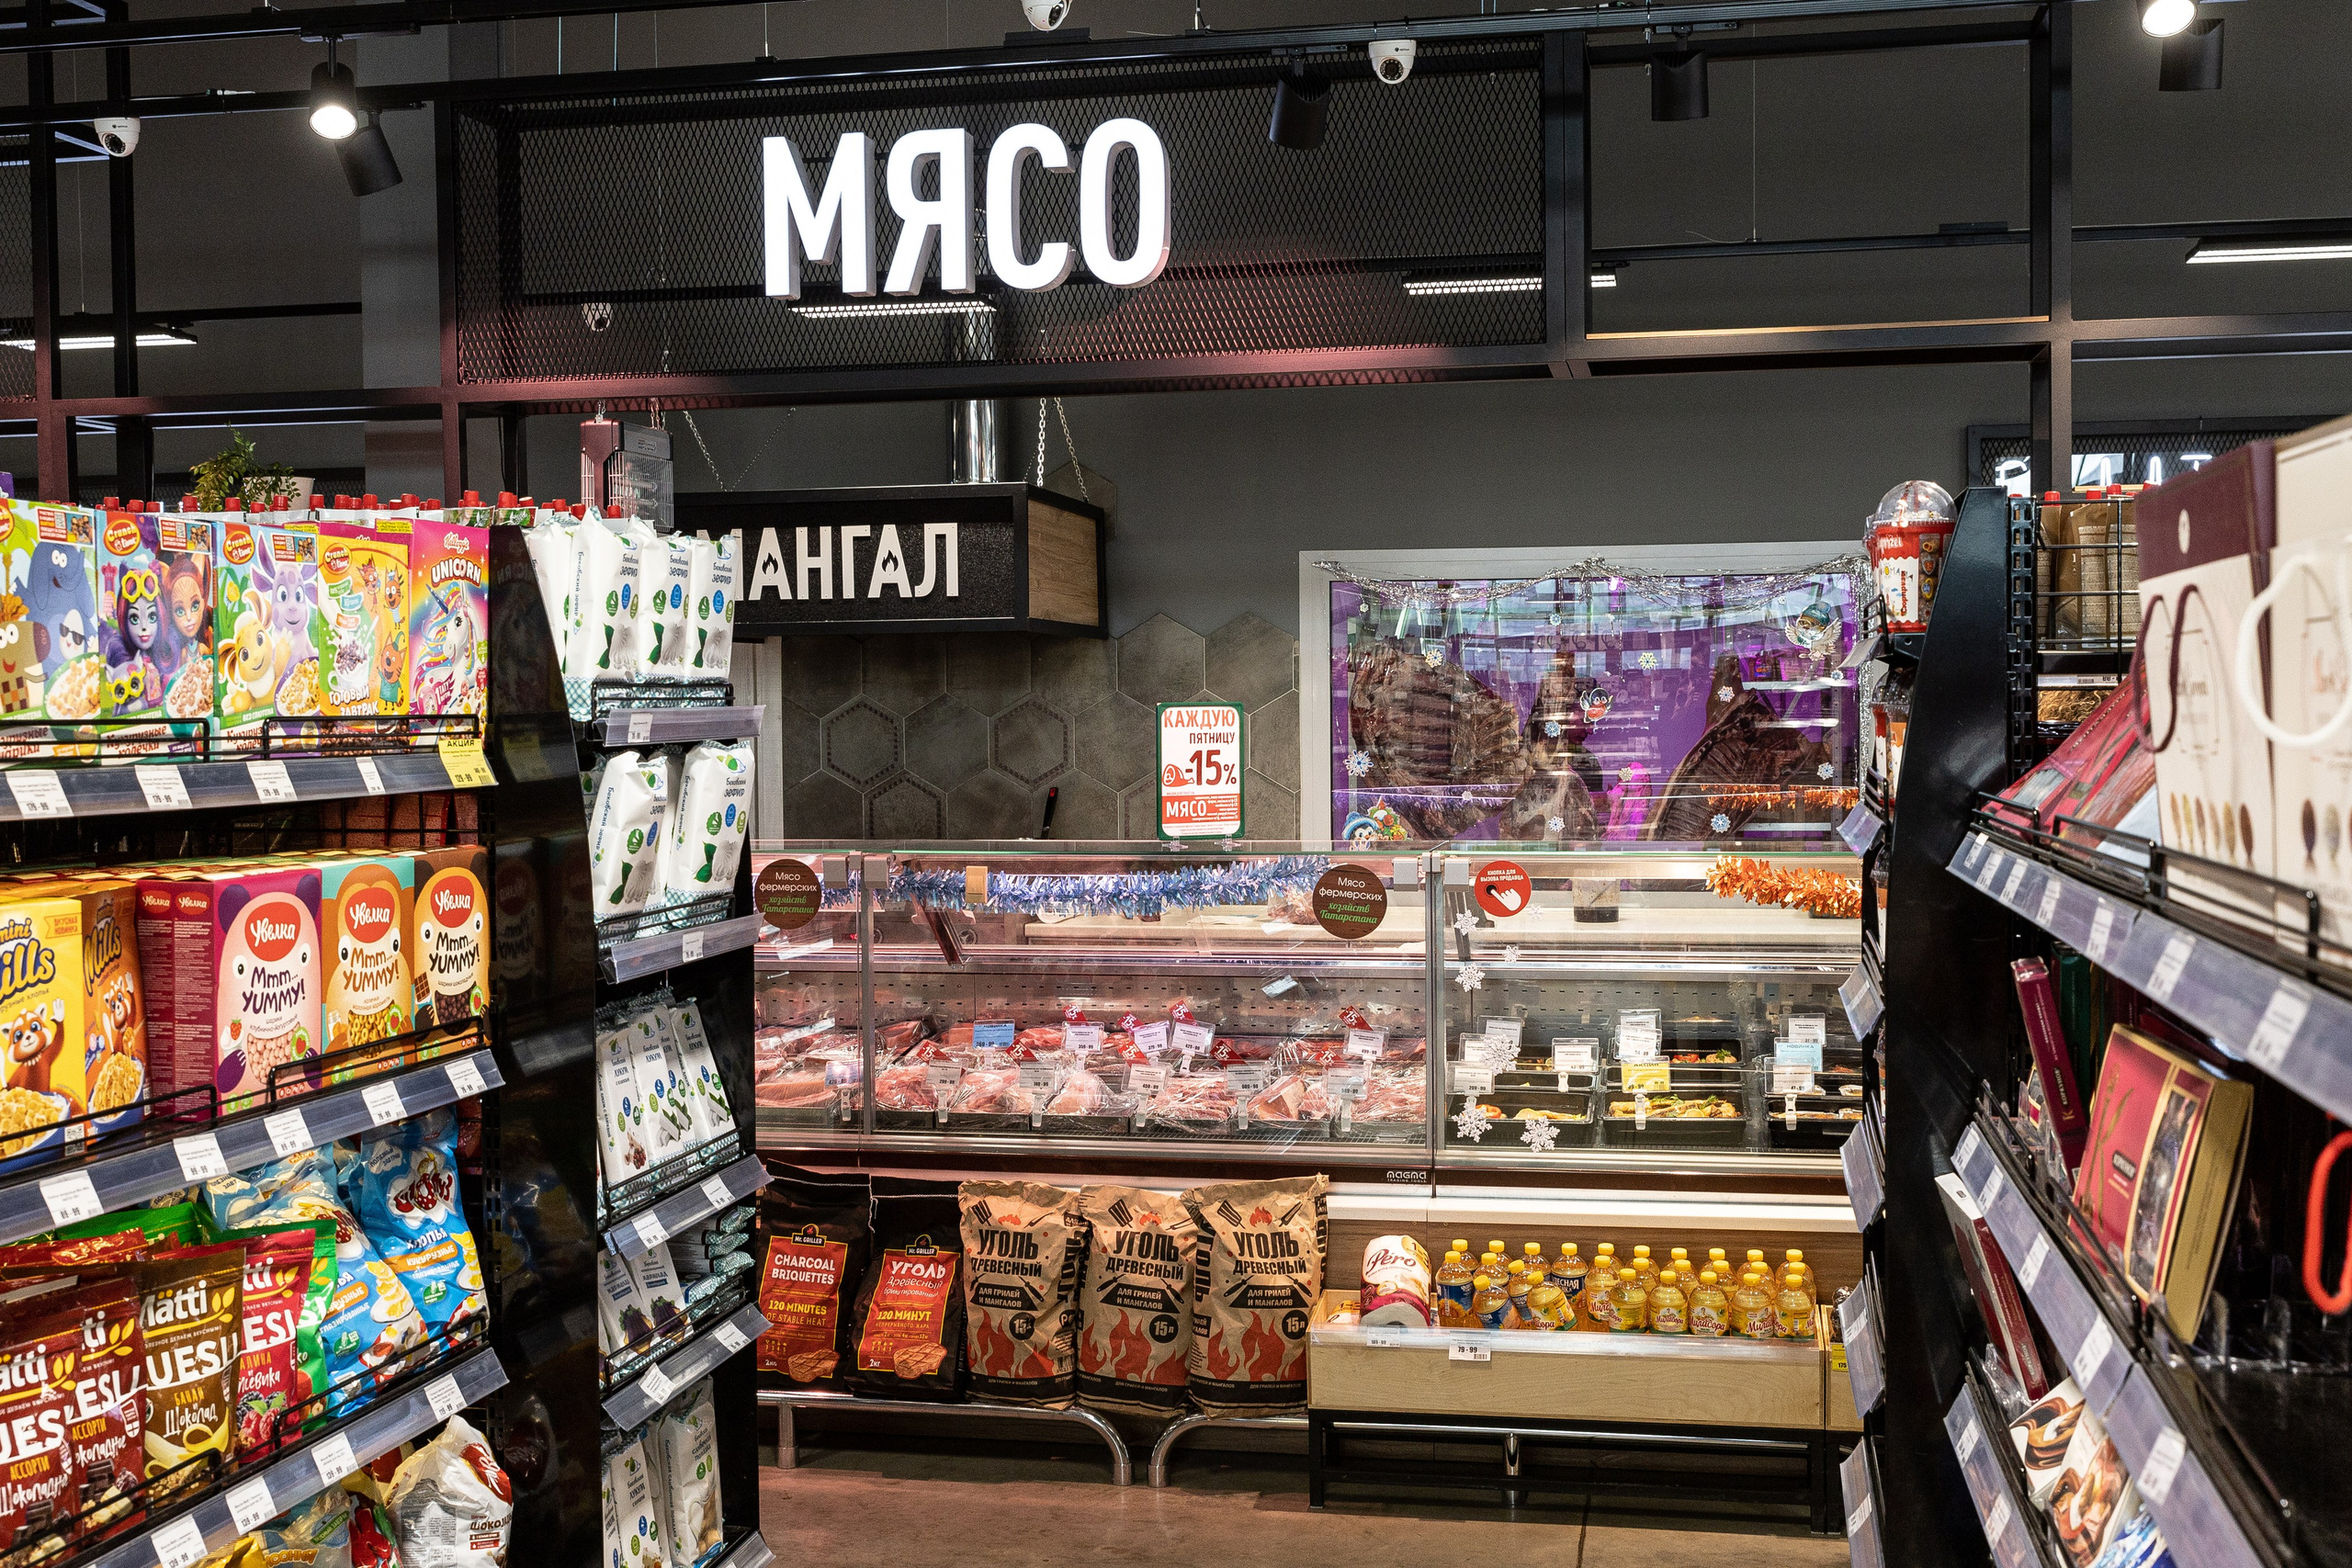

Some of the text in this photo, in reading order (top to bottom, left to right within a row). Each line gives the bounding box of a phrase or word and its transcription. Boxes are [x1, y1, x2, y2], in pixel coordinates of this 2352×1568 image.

[763, 118, 1168, 298] МЯСО
[107, 525, 138, 542] Crunch
[226, 537, 252, 553] Crunch
[324, 547, 348, 563] Crunch
[431, 558, 481, 587] UNICORN
[329, 685, 369, 705] ГОТОВЫЙ
[341, 701, 379, 716] ЗАВТРАК
[1164, 709, 1235, 729] КАЖДУЮ
[447, 739, 475, 748] АКЦИЯ
[1190, 732, 1235, 744] ПЯТНИЦУ
[1166, 800, 1207, 818] МЯСО
[775, 872, 800, 881] Мясо
[1338, 877, 1365, 888] Мясо
[759, 883, 817, 892] фермерских
[1318, 888, 1383, 902] фермерских
[178, 896, 208, 910] Увелка
[435, 889, 471, 911] Увелка
[769, 896, 807, 905] хозяйств
[1328, 902, 1370, 914] хозяйств
[349, 903, 390, 929] Увелка
[763, 904, 815, 914] Татарстана
[1320, 909, 1377, 924] Татарстана
[250, 917, 296, 946] Увелка
[429, 946, 481, 975] YUMMY!
[0, 938, 55, 1004] ills
[343, 966, 400, 992] YUMMY!
[242, 979, 306, 1014] YUMMY!
[978, 1228, 1039, 1259] УГОЛЬ
[1114, 1231, 1180, 1262] УГОЛЬ
[1233, 1231, 1299, 1258] УГОЛЬ
[406, 1245, 455, 1267] КУКУРУЗНЫЕ
[775, 1254, 836, 1271] CHARCOAL
[1365, 1249, 1416, 1275] Péro
[243, 1257, 274, 1292] tti
[891, 1260, 946, 1280] УГОЛЬ
[971, 1258, 1042, 1278] ДРЕВЕСНЫЙ
[1106, 1258, 1183, 1280] ДРЕВЕСНЫЙ
[1233, 1258, 1306, 1275] ДРЕВЕСНЫЙ
[771, 1268, 834, 1285] BRIQUETTES
[978, 1288, 1020, 1298] ДЛЯ ГРИЛЕЙ
[1133, 1290, 1161, 1300] ГРИЛЕЙ
[1264, 1288, 1291, 1297] ГРИЛЕЙ
[768, 1300, 827, 1315] 120 MINUTES
[985, 1297, 1022, 1308] МАНГАЛОВ
[1124, 1298, 1162, 1309] МАНГАЛОВ
[1248, 1297, 1293, 1306] И МАНГАЛОВ
[766, 1314, 826, 1326] OF STABLE HEAT
[877, 1311, 932, 1321] 120 МИНУТ
[0, 1344, 48, 1392] ätti
[146, 1333, 238, 1386] UESLI
[240, 1351, 272, 1370] АЛИНА
[174, 1387, 205, 1404] БАНАН
[72, 1417, 107, 1441] АССОРТИ
[75, 1436, 127, 1468] околадное
[9, 1456, 51, 1481] АССОРТИ
